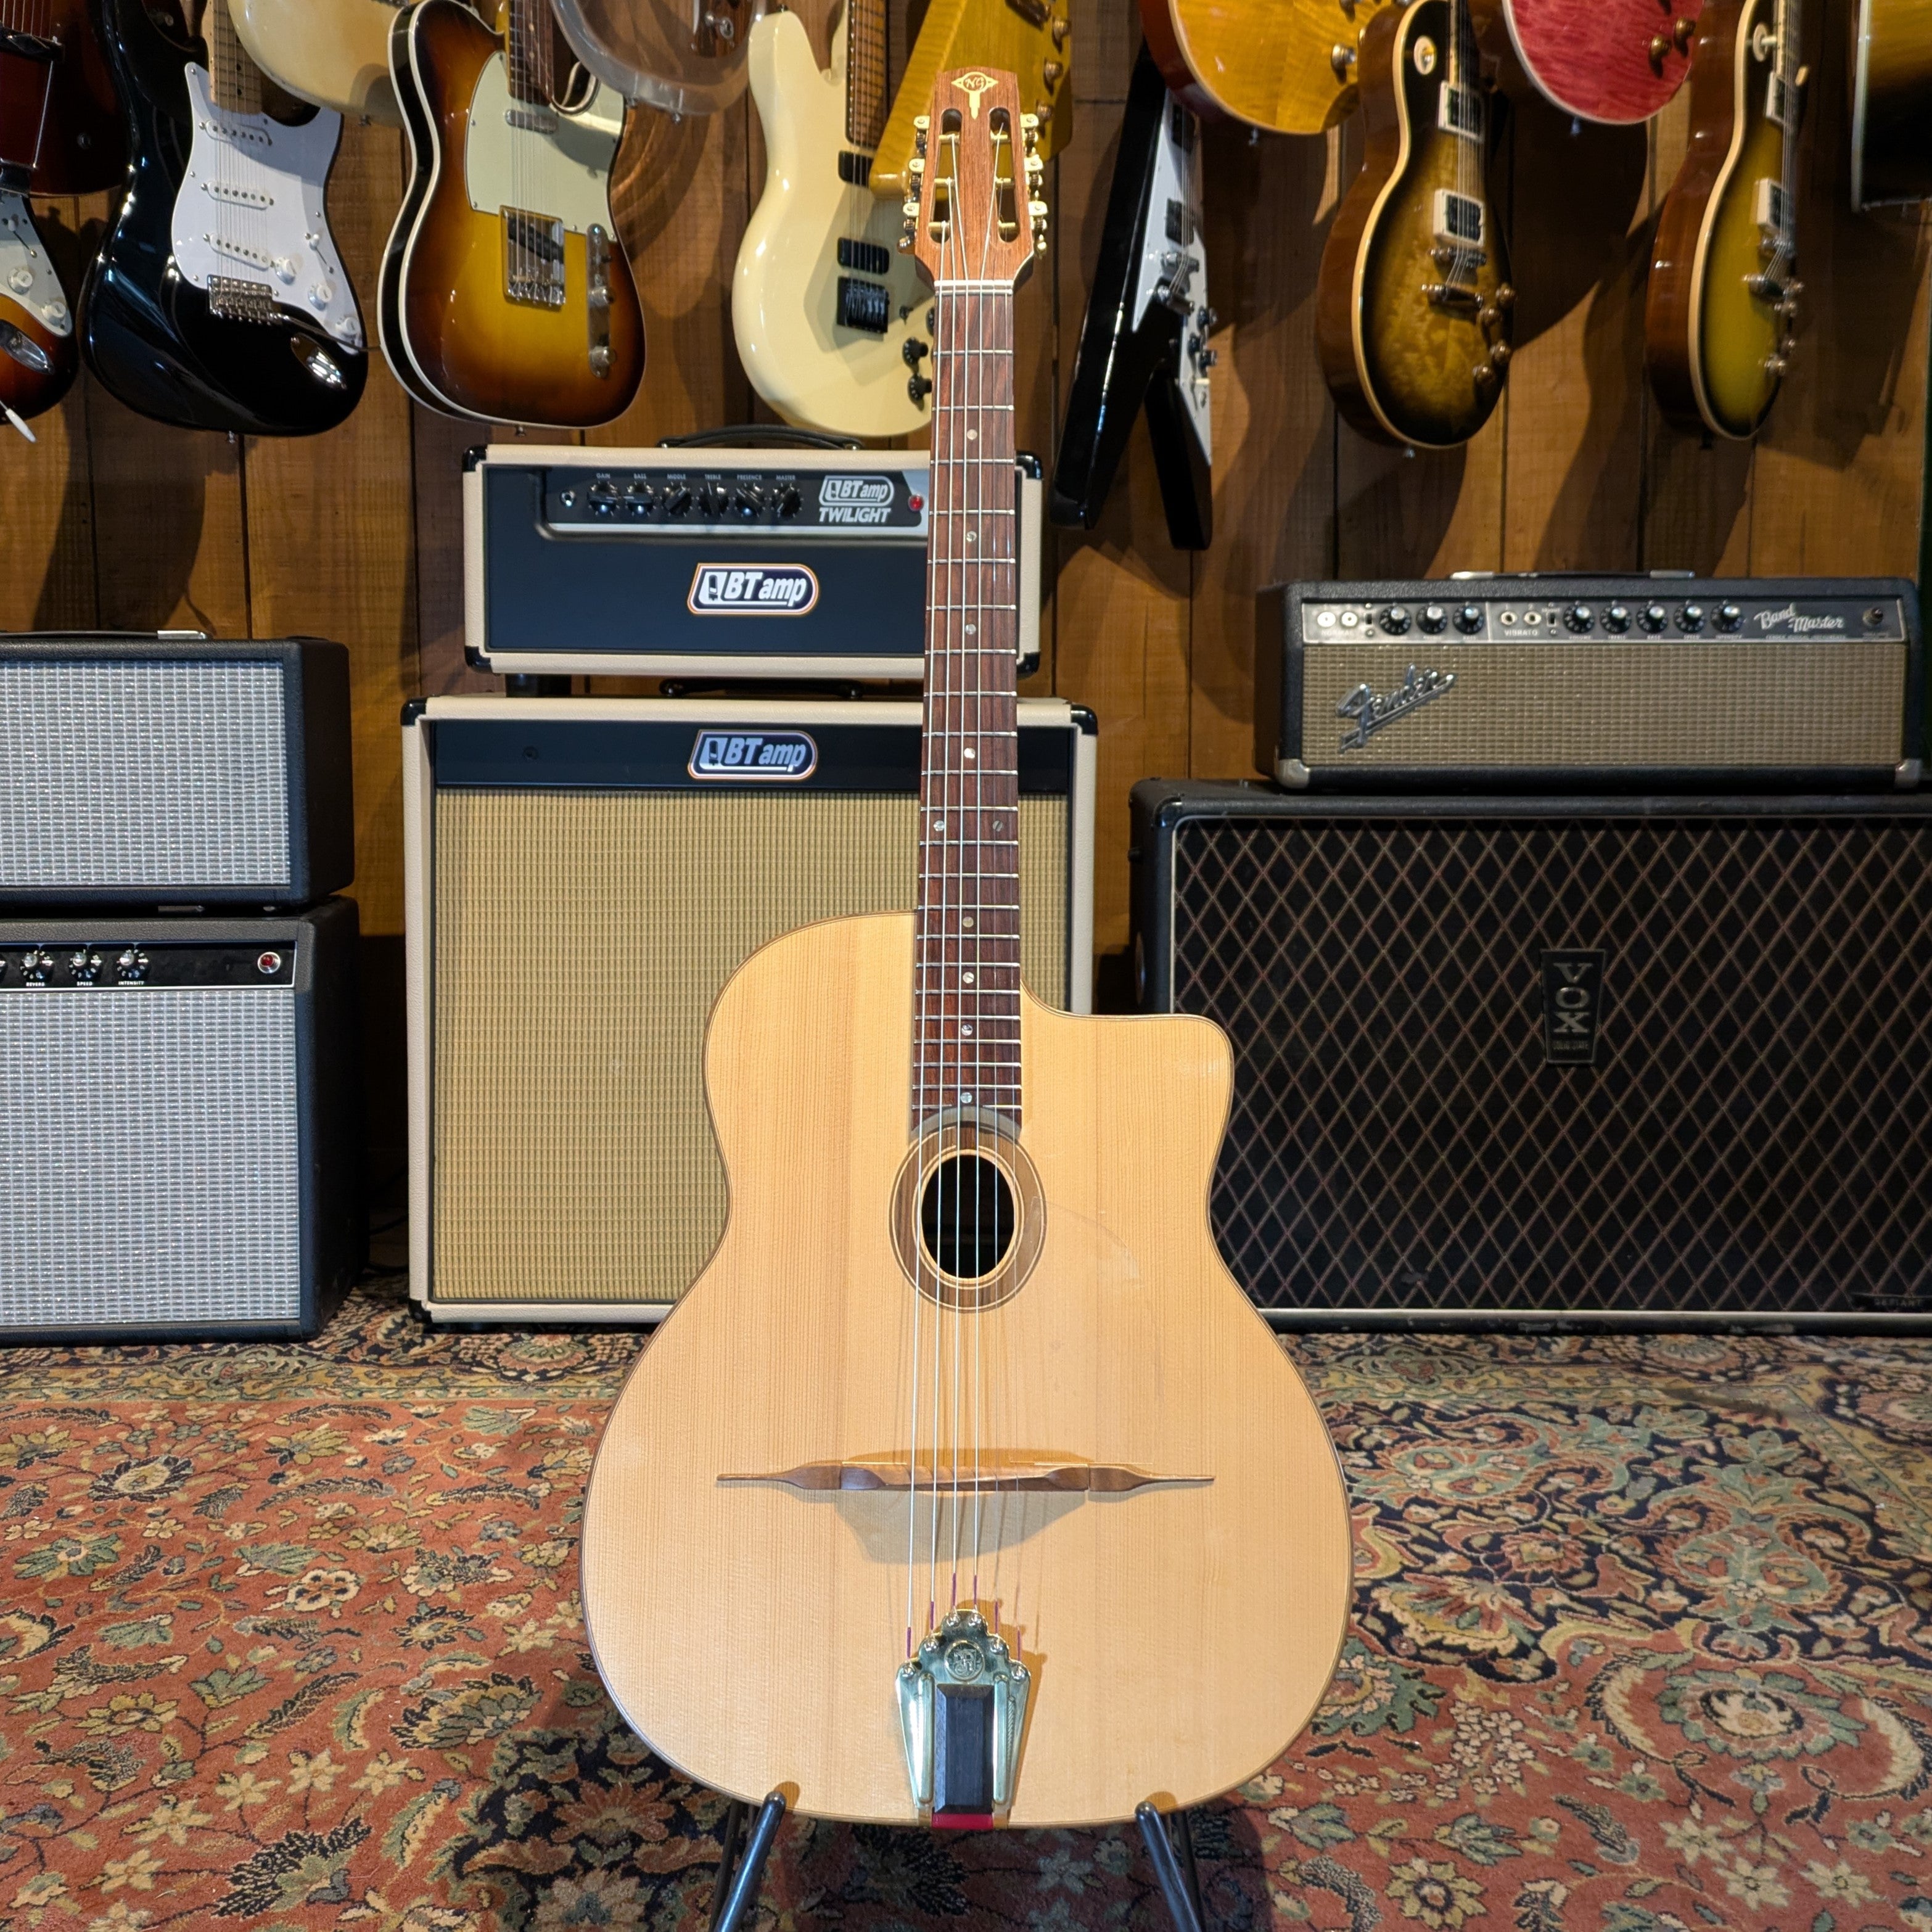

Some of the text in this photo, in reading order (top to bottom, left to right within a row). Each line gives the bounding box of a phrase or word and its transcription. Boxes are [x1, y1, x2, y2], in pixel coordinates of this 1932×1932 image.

[840, 480, 888, 502] BT amp
[819, 508, 891, 522] TWILIGHT
[724, 572, 807, 606] BT amp
[1753, 602, 1796, 629] Band
[1336, 662, 1455, 753] Fender
[725, 738, 806, 772] BT amp
[1553, 963, 1593, 1033] VOX
